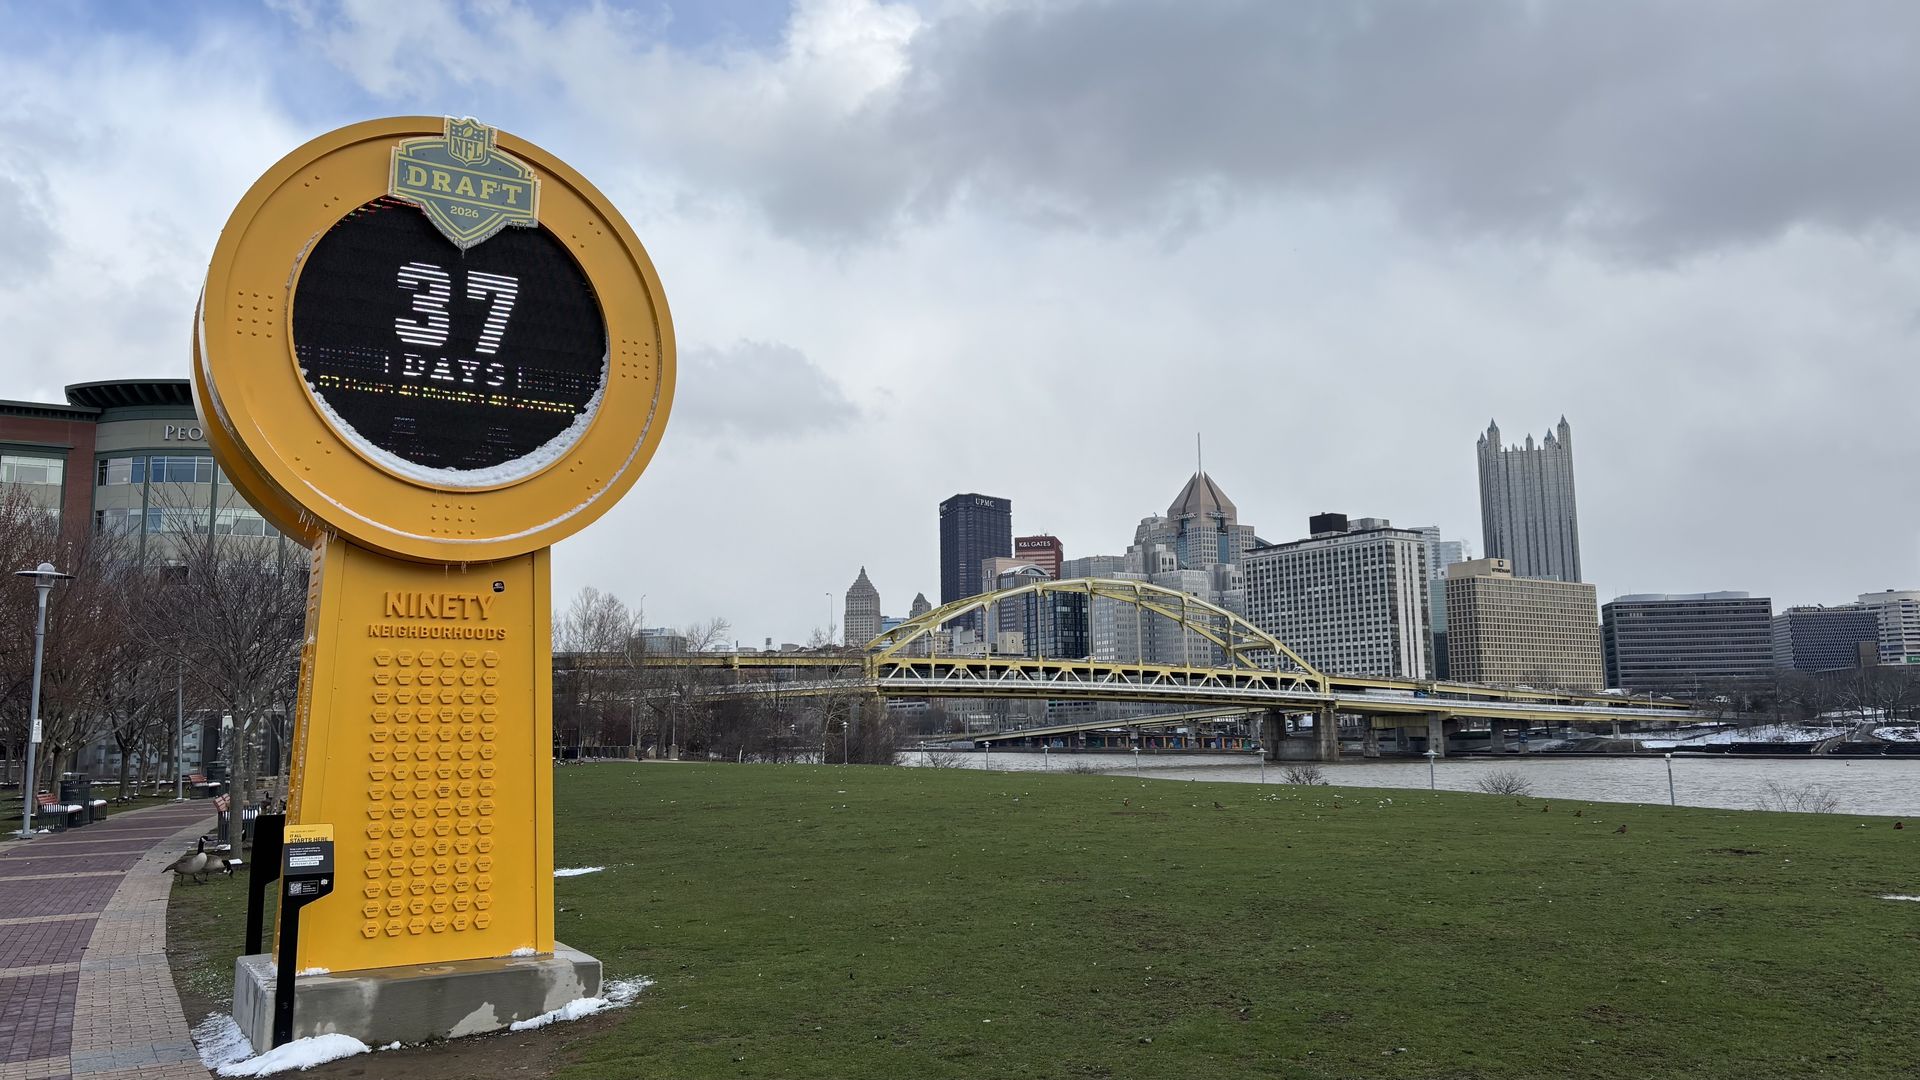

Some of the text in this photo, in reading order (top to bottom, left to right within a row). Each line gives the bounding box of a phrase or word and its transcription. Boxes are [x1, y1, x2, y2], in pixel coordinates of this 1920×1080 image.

[452, 137, 482, 160] NFL
[406, 165, 523, 205] DRAFT
[450, 205, 479, 218] 2026
[394, 261, 519, 354] 37
[402, 353, 505, 386] DAYS
[163, 424, 205, 441] PEO
[975, 497, 995, 508] UPMC
[1030, 540, 1051, 548] GATES
[384, 591, 497, 621] NINETY
[368, 624, 507, 641] NEIGHBORHOODS
